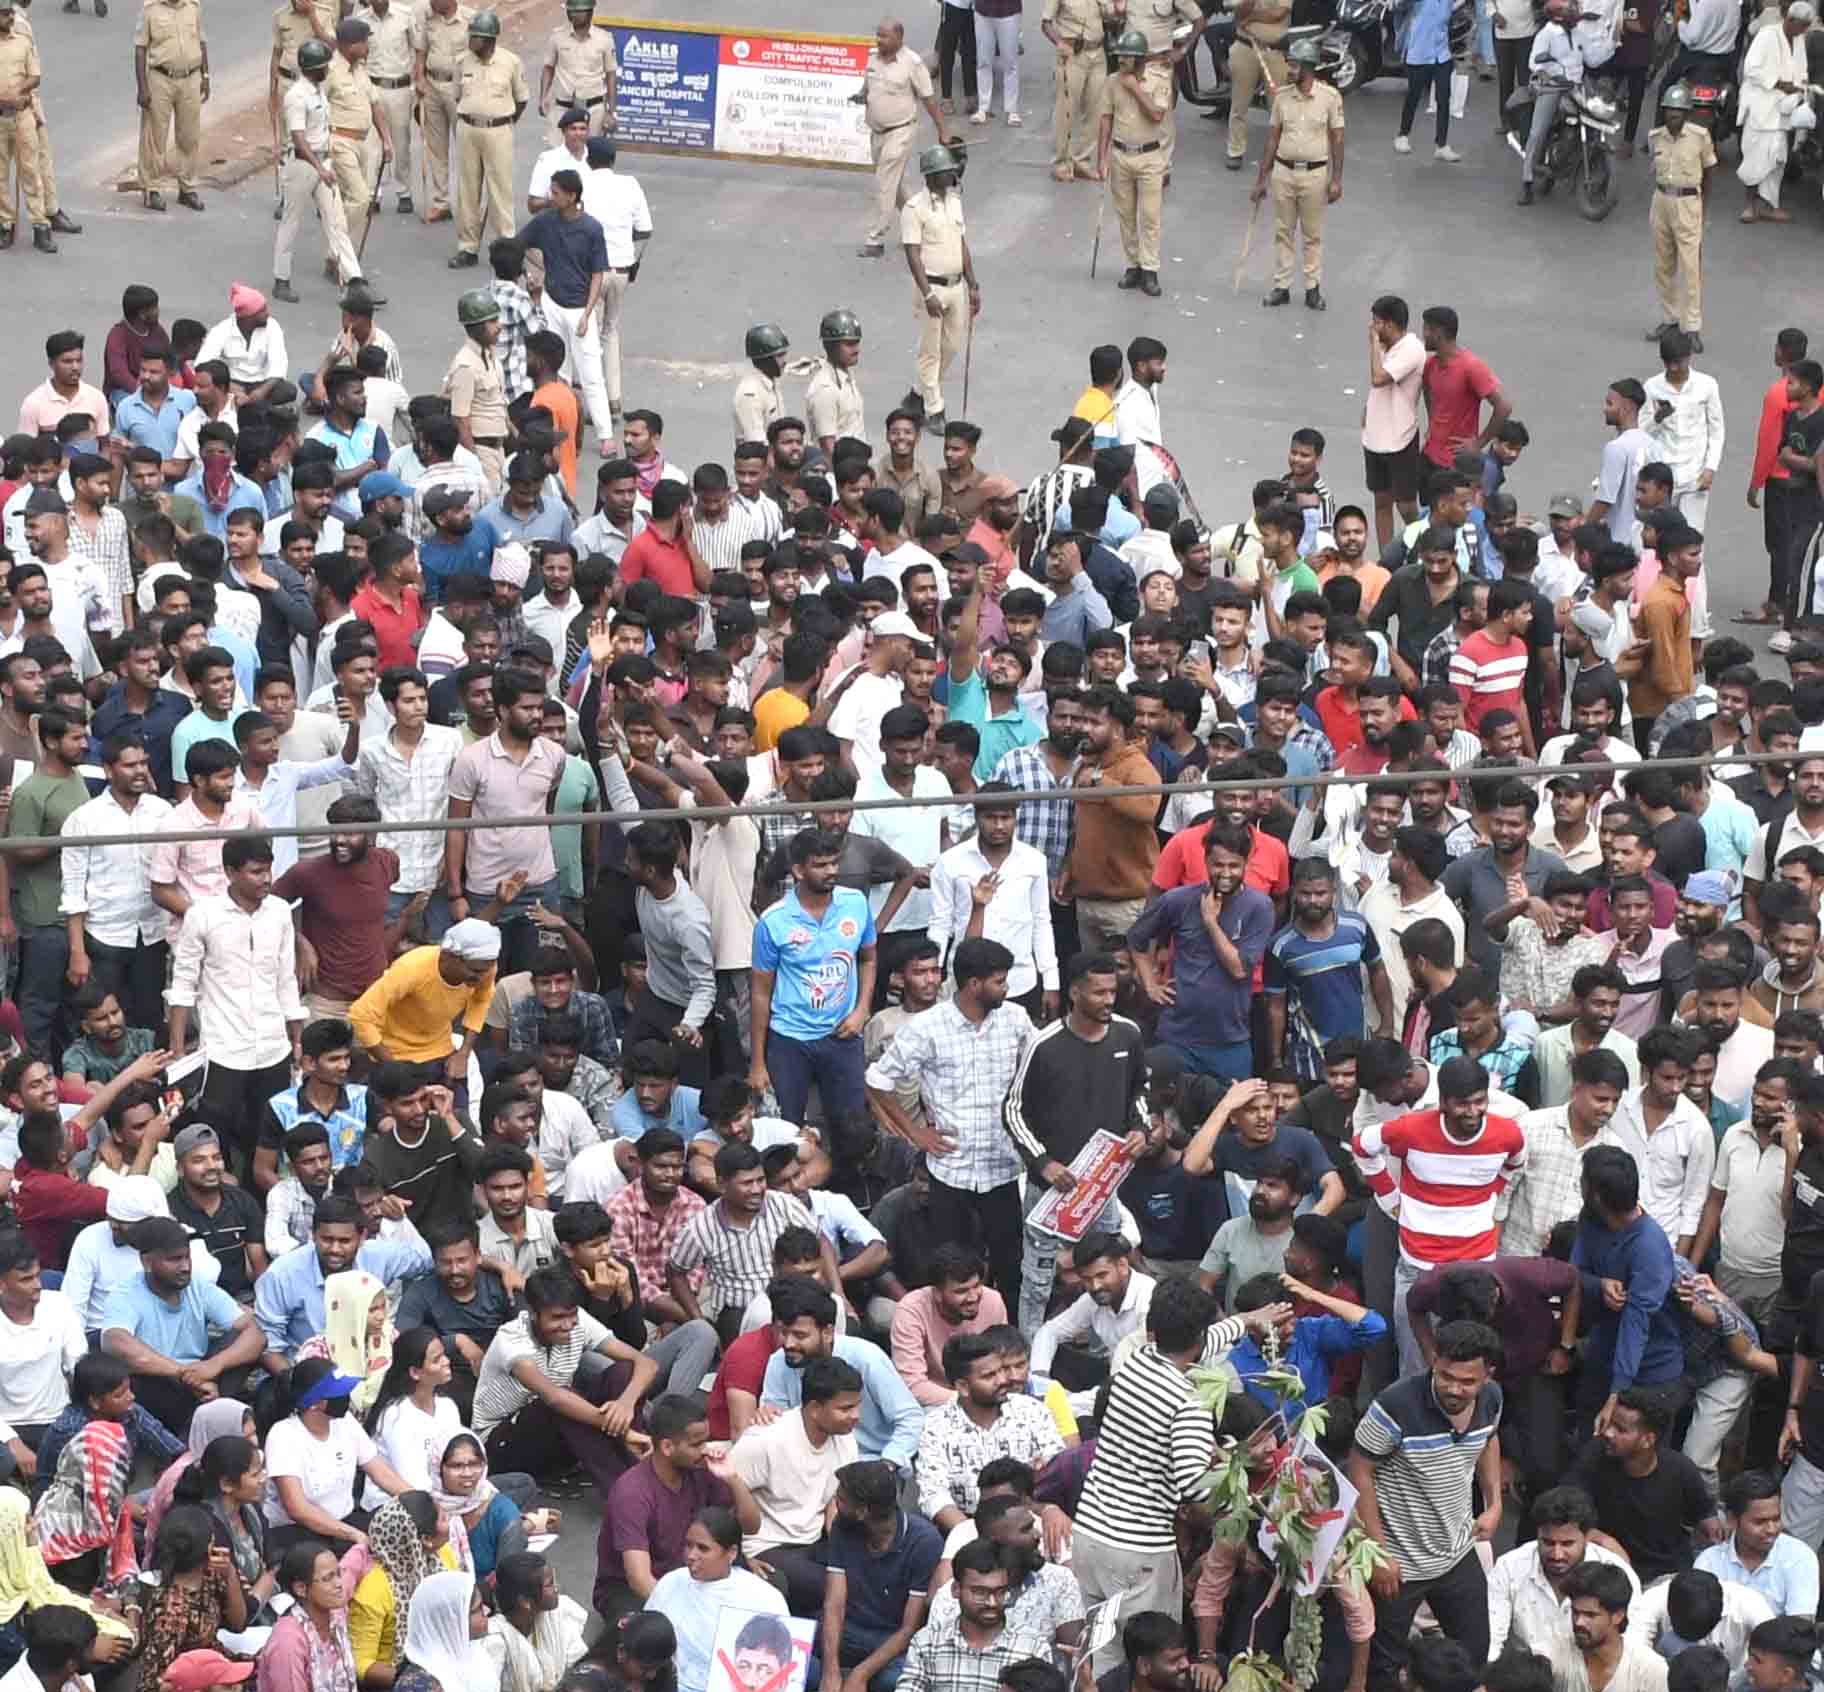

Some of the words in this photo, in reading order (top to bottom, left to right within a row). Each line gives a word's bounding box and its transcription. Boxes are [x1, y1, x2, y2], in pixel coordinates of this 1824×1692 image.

[761, 52, 782, 62] CITY
[783, 53, 822, 65] TRAFFIC
[823, 57, 857, 67] POLICE
[657, 89, 704, 102] HOSPITAL
[782, 91, 825, 105] TRAFFIC
